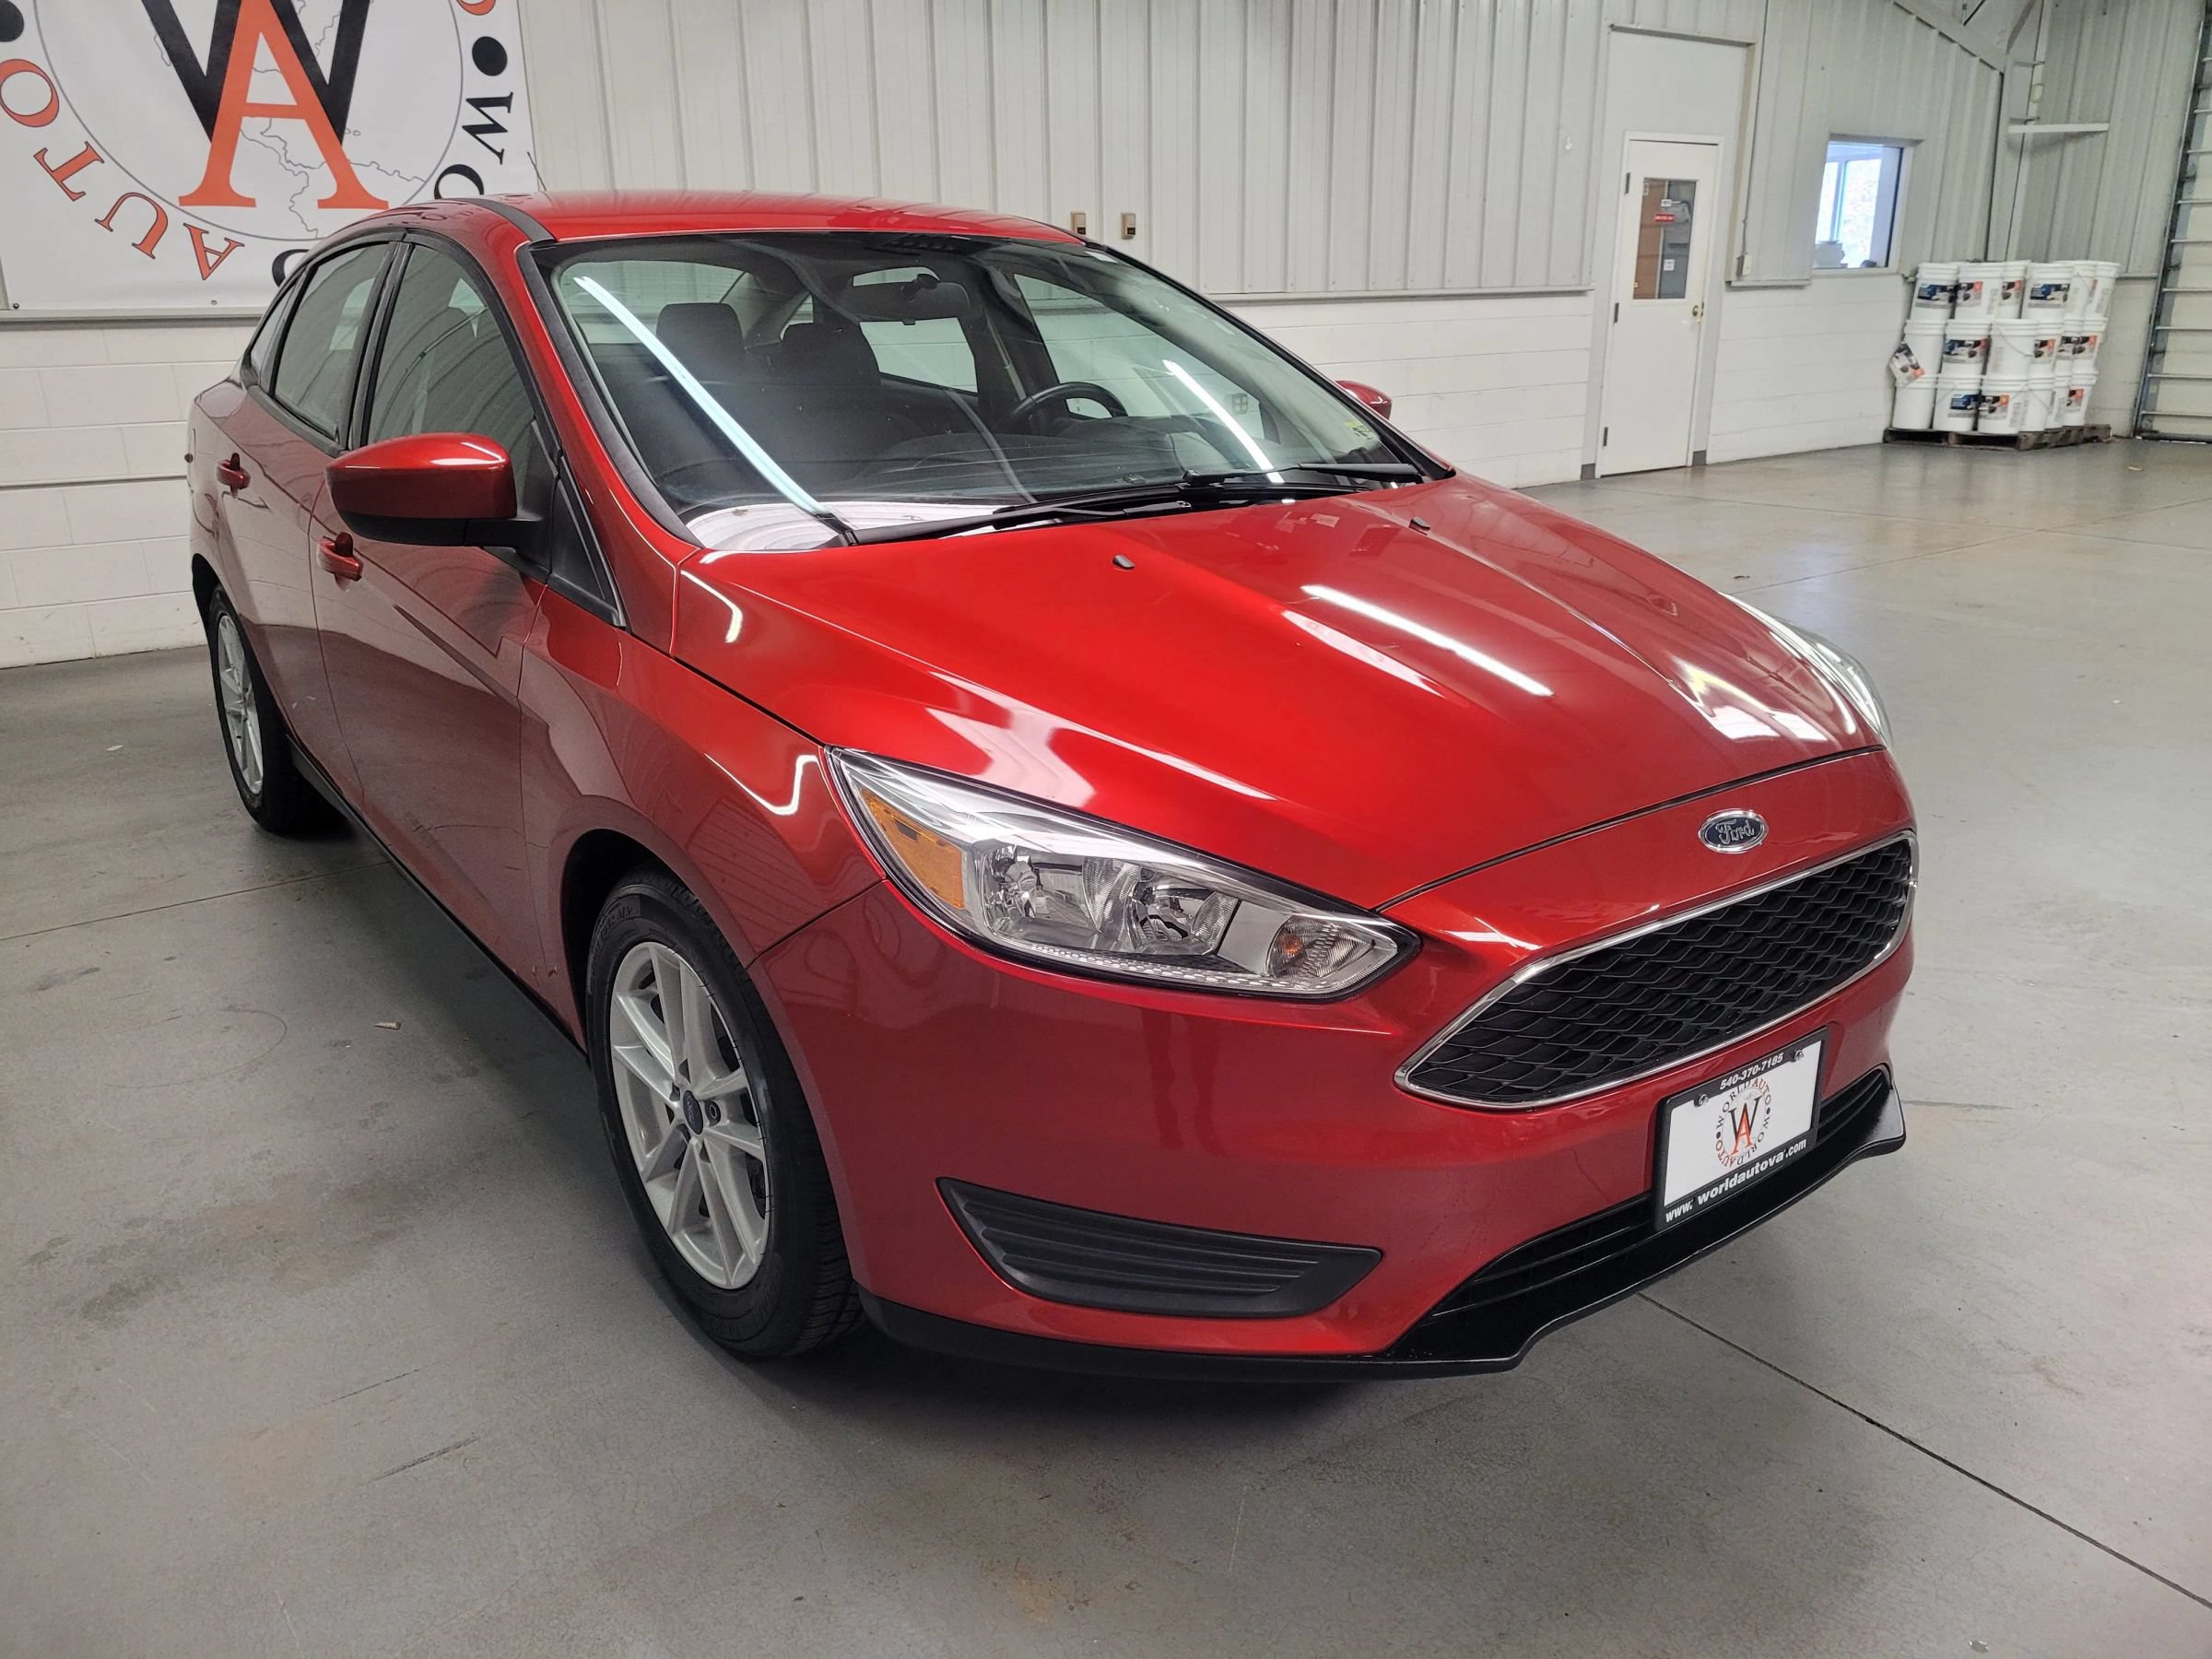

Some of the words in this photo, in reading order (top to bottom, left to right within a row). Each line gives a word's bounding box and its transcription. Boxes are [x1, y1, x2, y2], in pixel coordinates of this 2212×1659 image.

[0, 58, 245, 281] AUTO
[1715, 818, 1755, 844] Ford
[1720, 1052, 1783, 1090] 540-370-7185
[1752, 1077, 1771, 1106] AUTO
